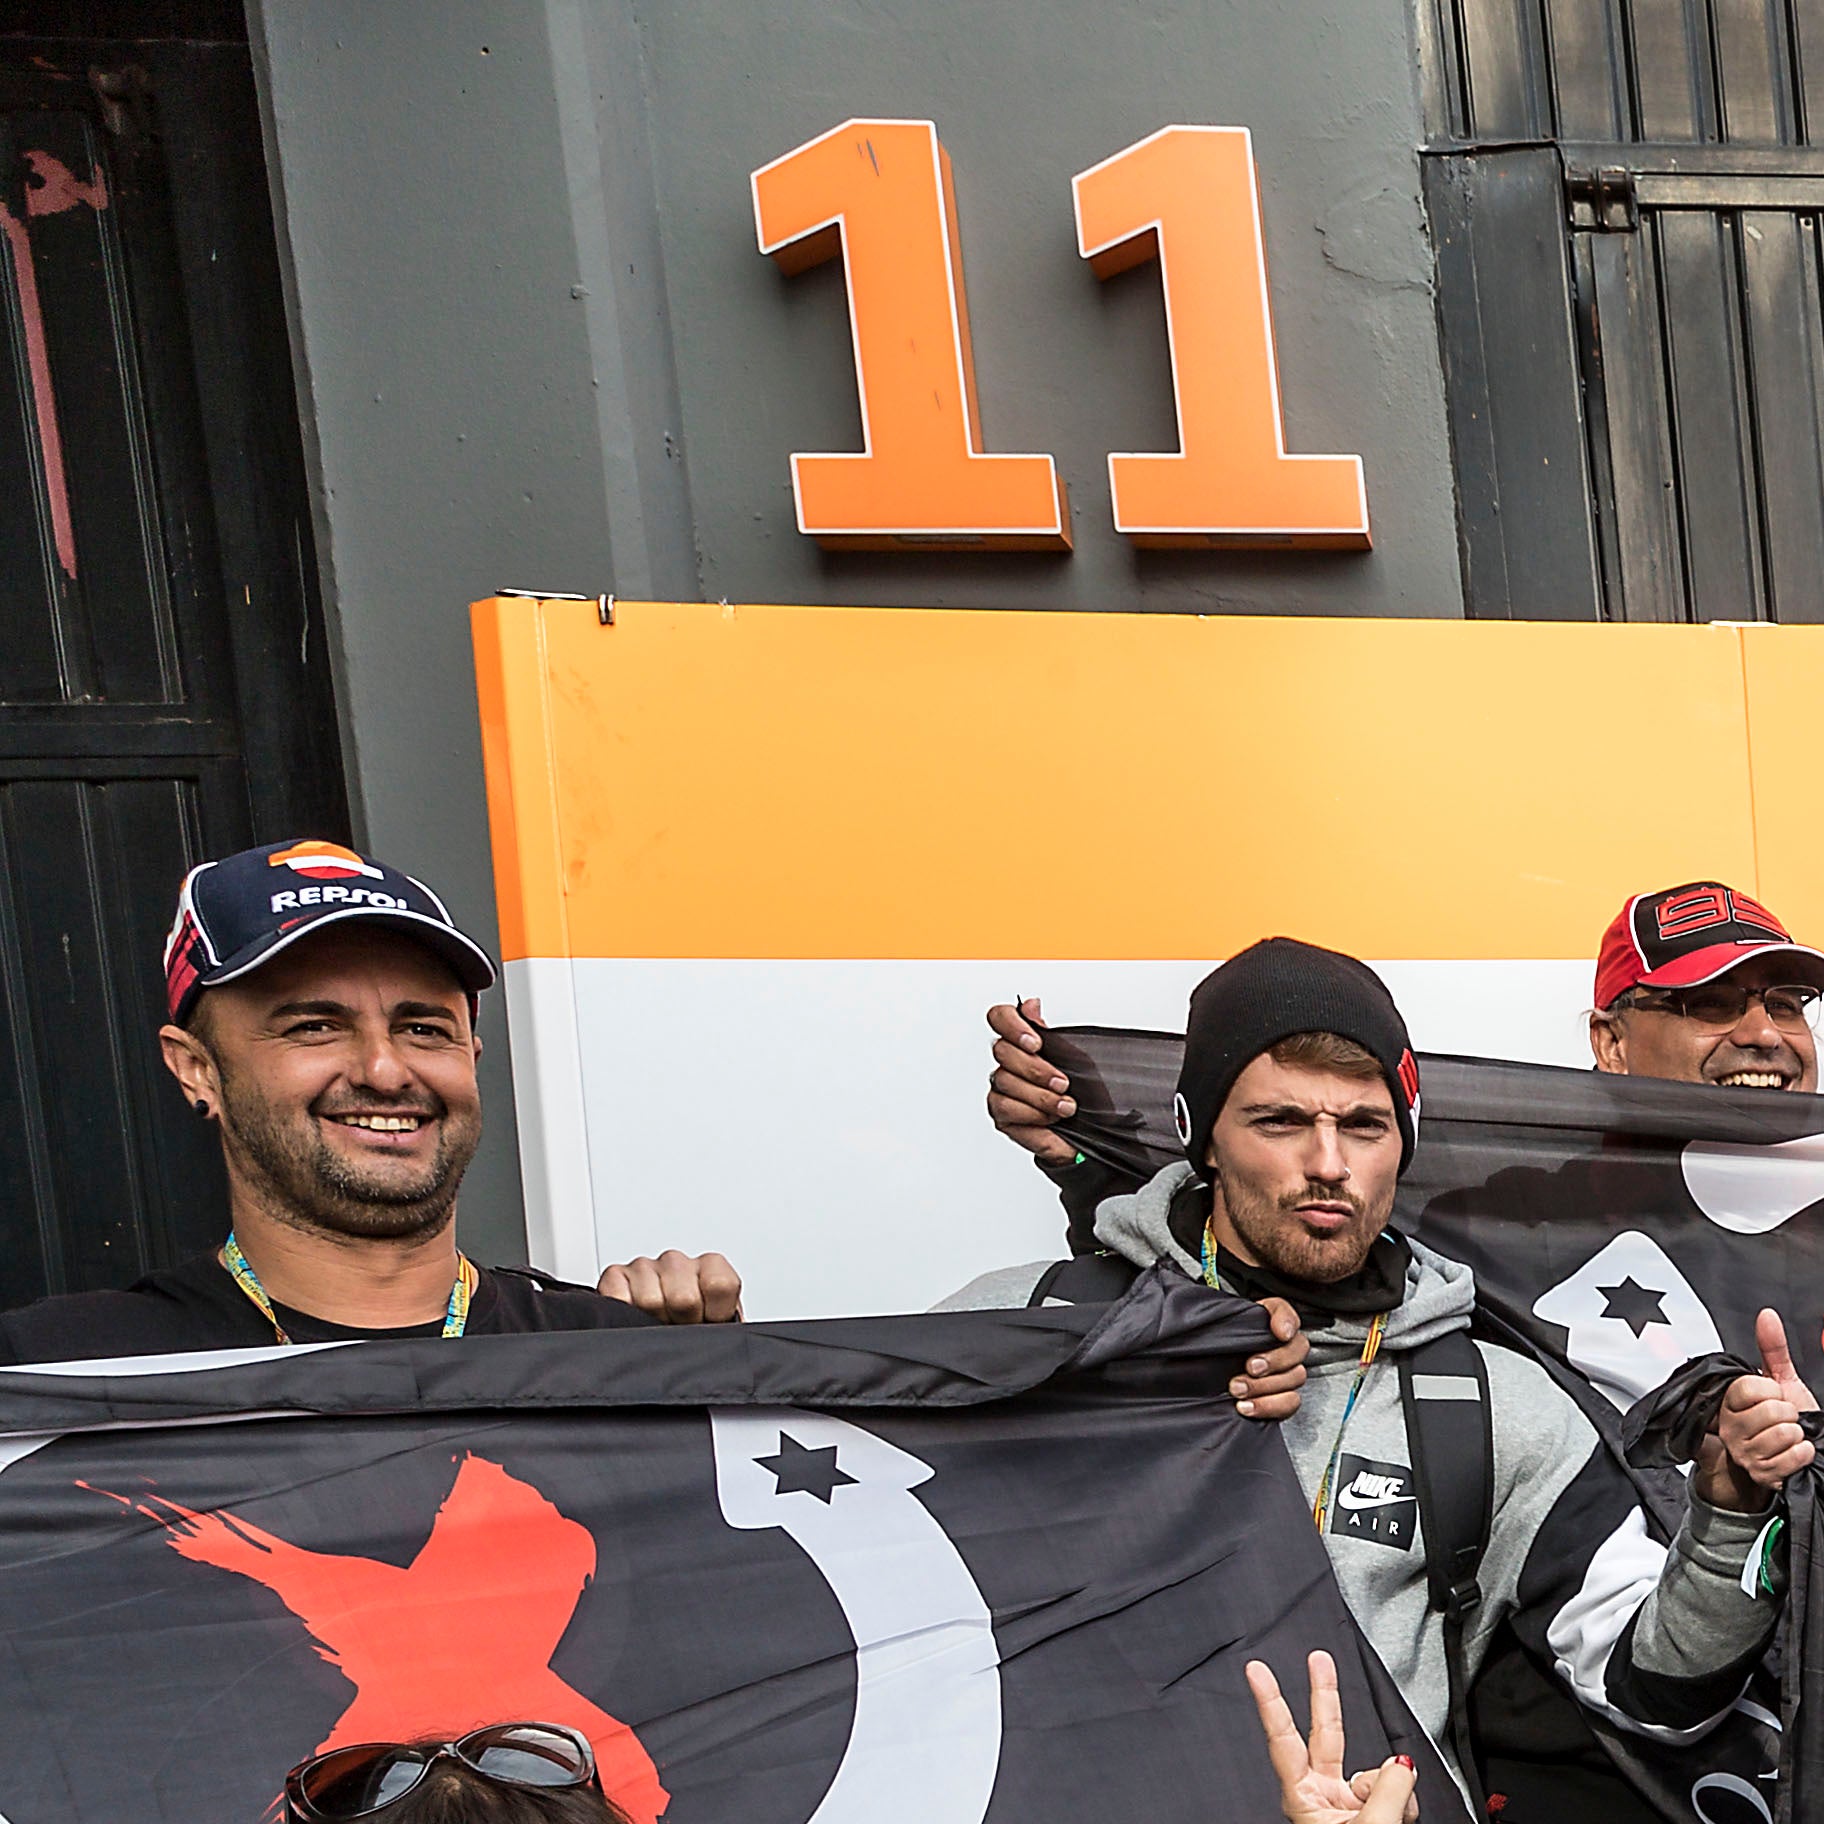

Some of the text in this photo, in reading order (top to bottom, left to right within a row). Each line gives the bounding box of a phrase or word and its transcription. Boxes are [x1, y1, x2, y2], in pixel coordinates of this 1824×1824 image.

[750, 115, 1372, 550] 11
[1351, 1469, 1405, 1498] NIKE
[1348, 1512, 1399, 1535] AIR
